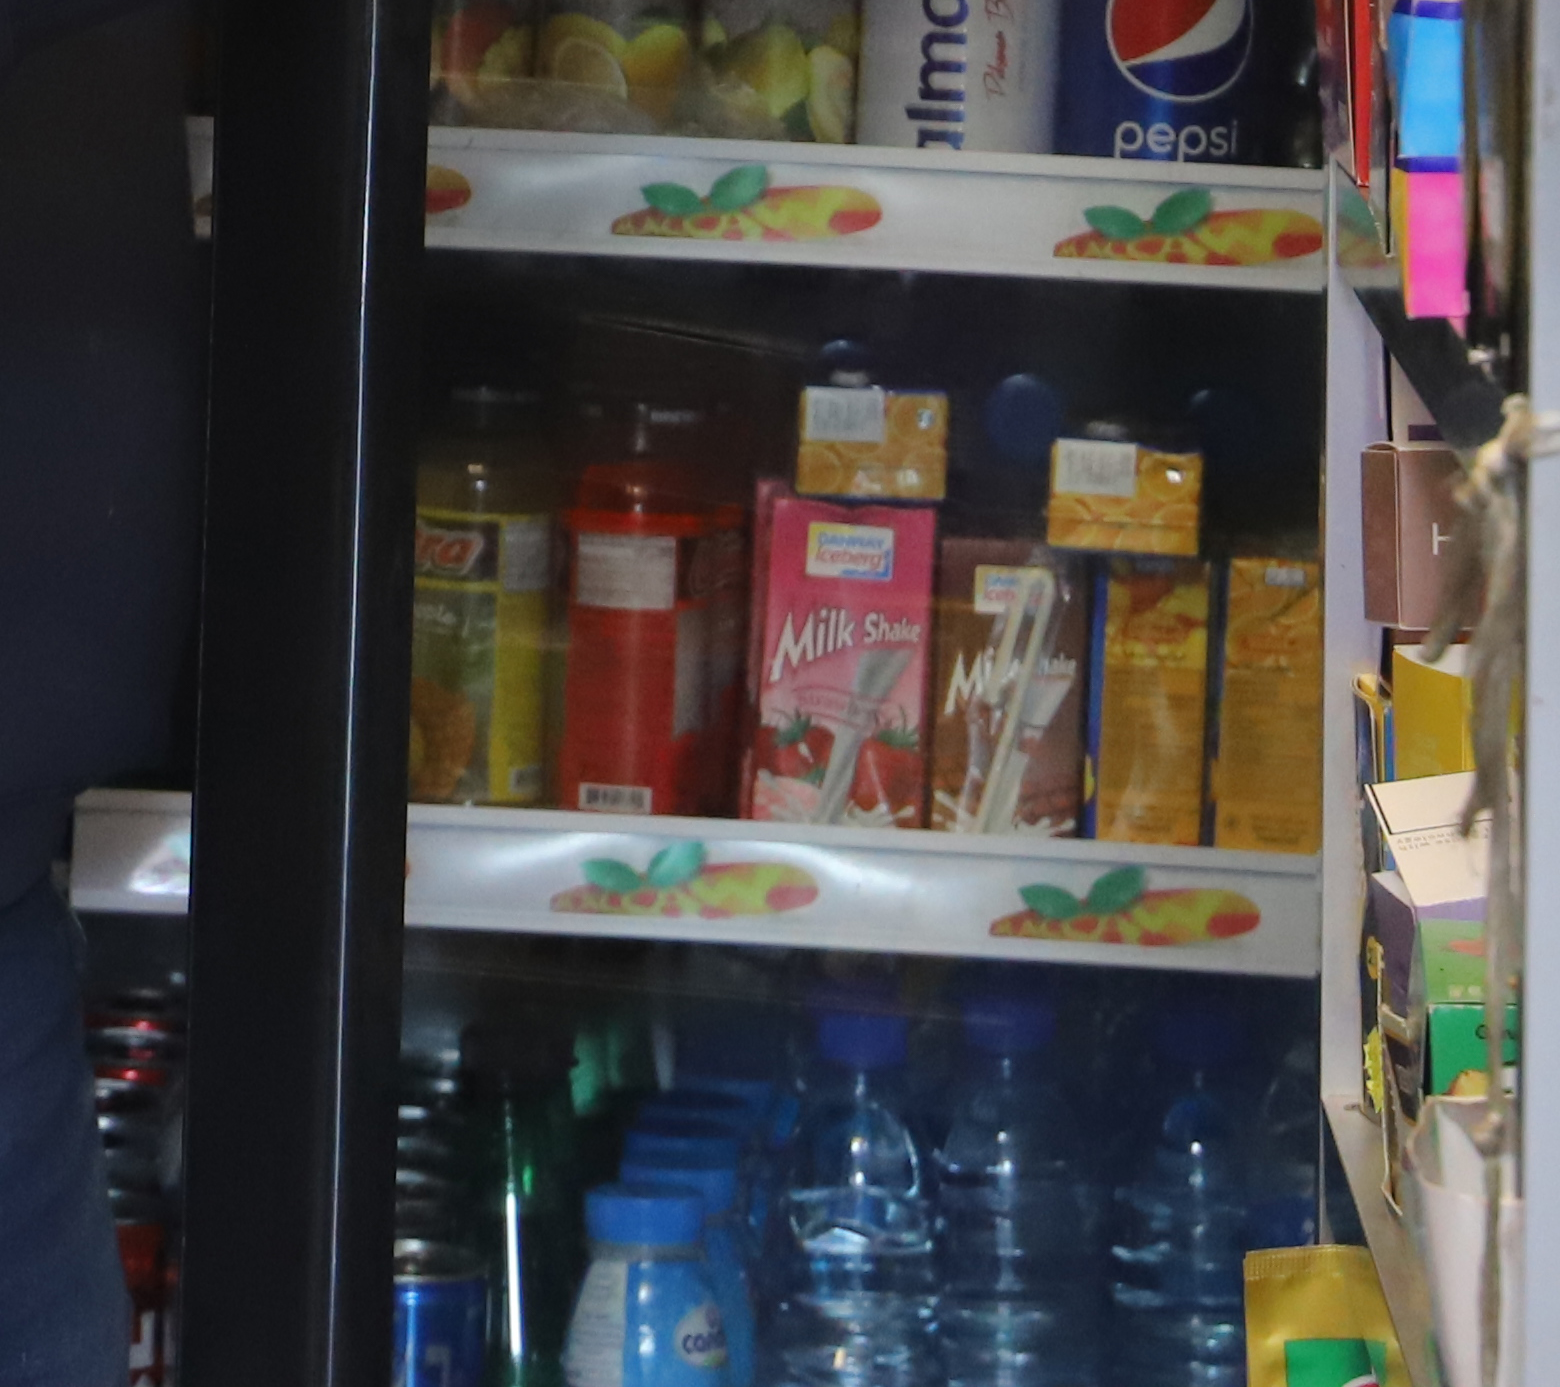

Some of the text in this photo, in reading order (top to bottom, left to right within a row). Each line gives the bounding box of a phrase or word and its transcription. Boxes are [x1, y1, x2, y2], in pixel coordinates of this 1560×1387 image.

[1112, 118, 1238, 163] pepsi
[770, 606, 921, 684] Milk Shake
